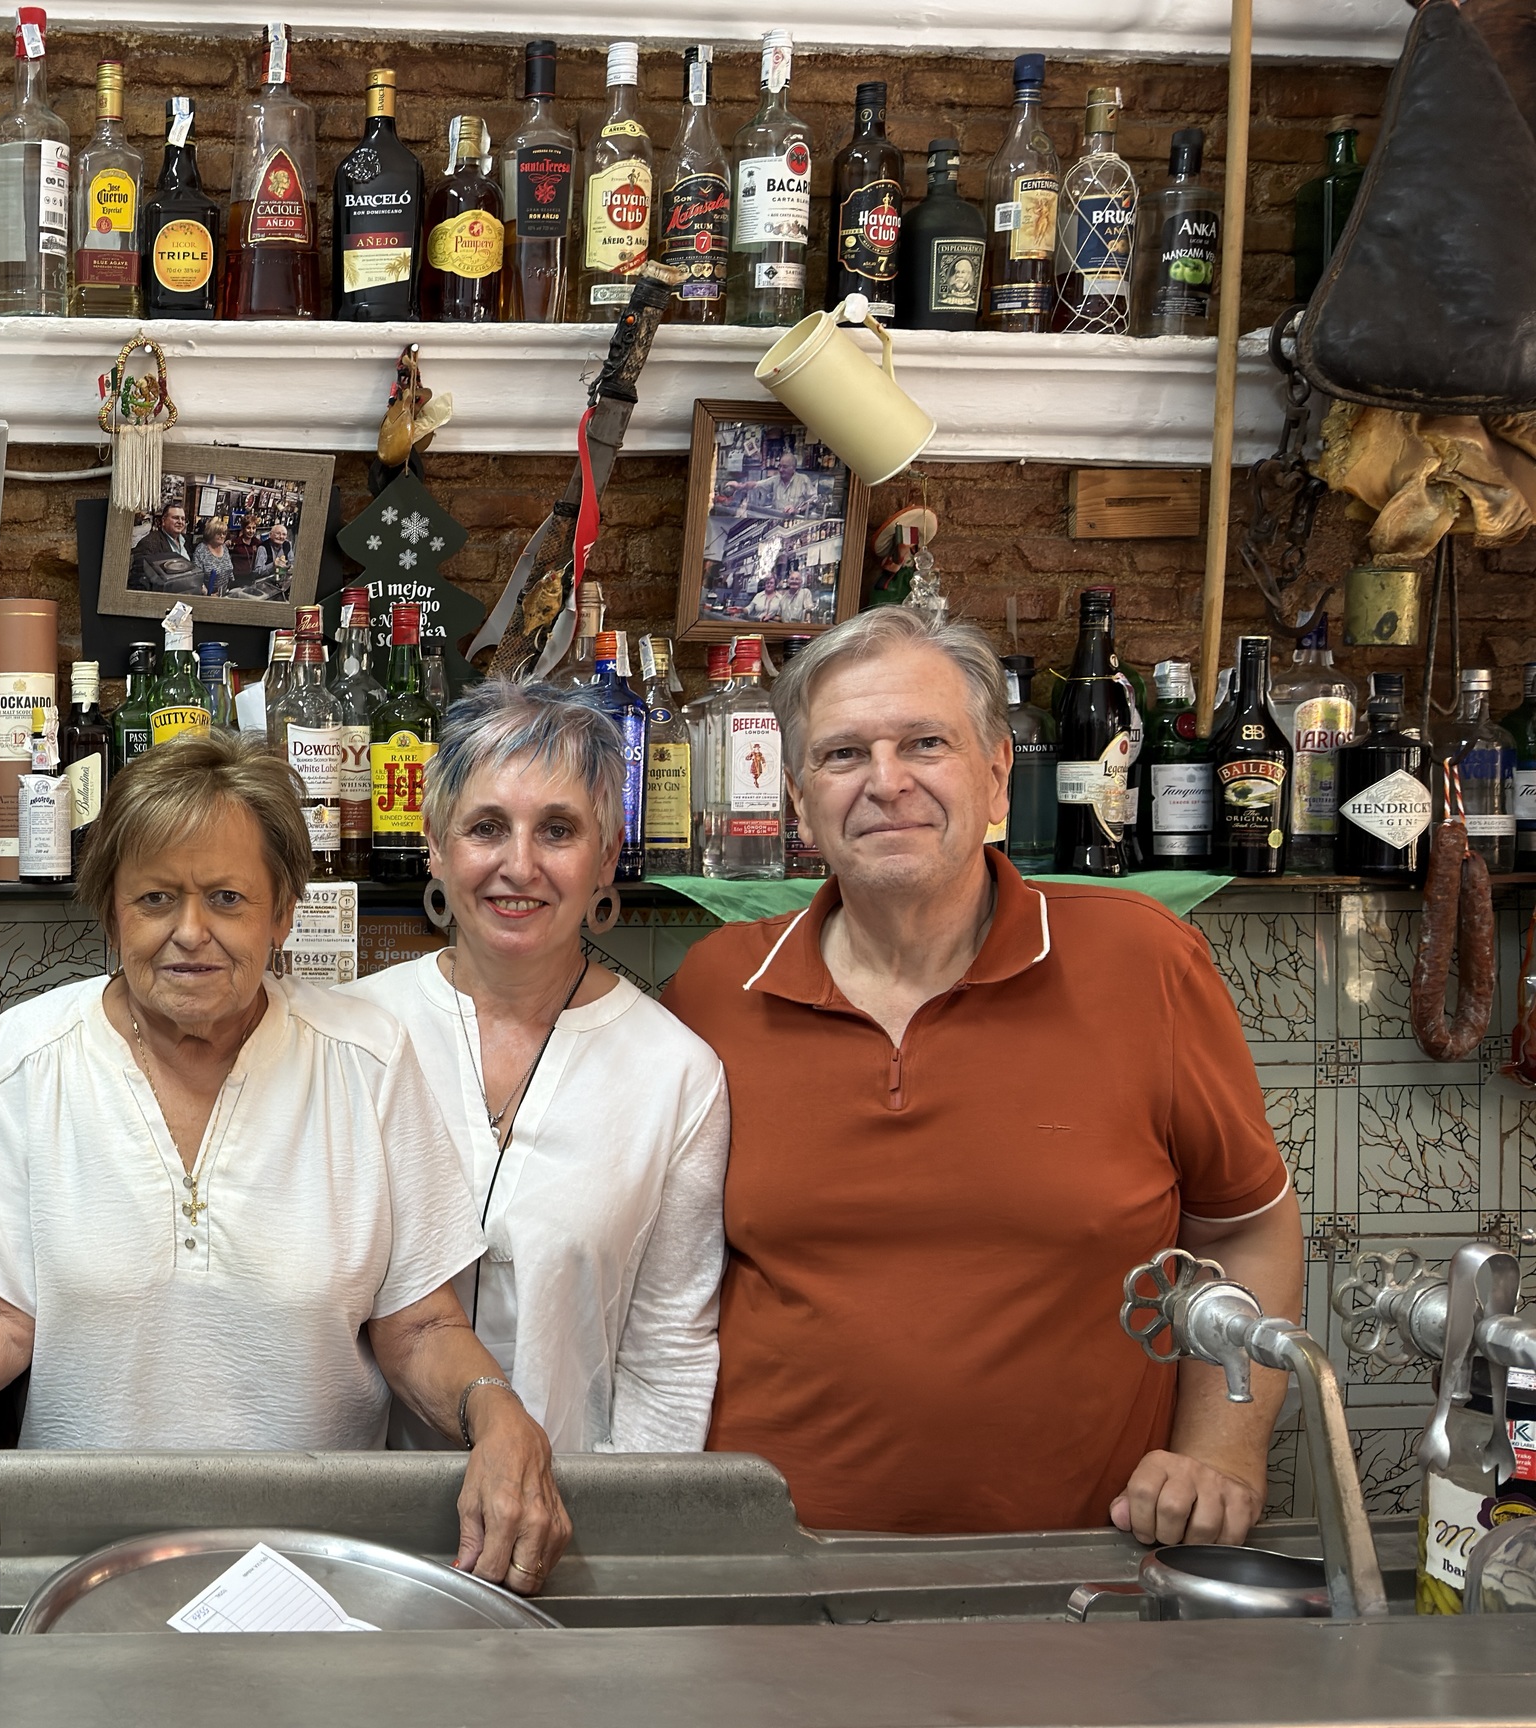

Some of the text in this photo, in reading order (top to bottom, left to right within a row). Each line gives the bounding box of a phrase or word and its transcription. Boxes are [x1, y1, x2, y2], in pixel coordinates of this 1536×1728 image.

[862, 109, 871, 120] 7
[629, 124, 637, 132] 3
[107, 182, 121, 193] Jose
[97, 189, 129, 205] Cuervo
[344, 190, 412, 208] BARCELÓ
[257, 204, 302, 216] CACIQUE
[366, 208, 402, 216] DOMINICANO
[542, 212, 559, 220] AÑEJO
[612, 207, 643, 223] Club
[266, 217, 295, 227] AÑEJO
[1178, 218, 1216, 239] ANKA
[602, 235, 634, 246] AÑEJO 3
[869, 226, 896, 242] Club
[357, 237, 399, 248] AÑEJO
[454, 235, 495, 255] Pampero
[699, 237, 708, 249] 7
[158, 251, 208, 261] TRIPLE
[1162, 247, 1204, 262] MANZANA
[457, 259, 492, 273] ESPECIAL
[877, 256, 888, 273] 7
[366, 579, 436, 600] El mejor
[154, 711, 188, 729] CUTTY
[13, 732, 26, 746] 12
[1296, 731, 1353, 753] LARIOS
[293, 741, 341, 756] Dewar's
[1222, 763, 1283, 779] BAILEYS
[664, 782, 681, 791] GIN
[30, 796, 56, 805] ANGOSTURA
[379, 937, 395, 947] de
[294, 954, 337, 963] 69407
